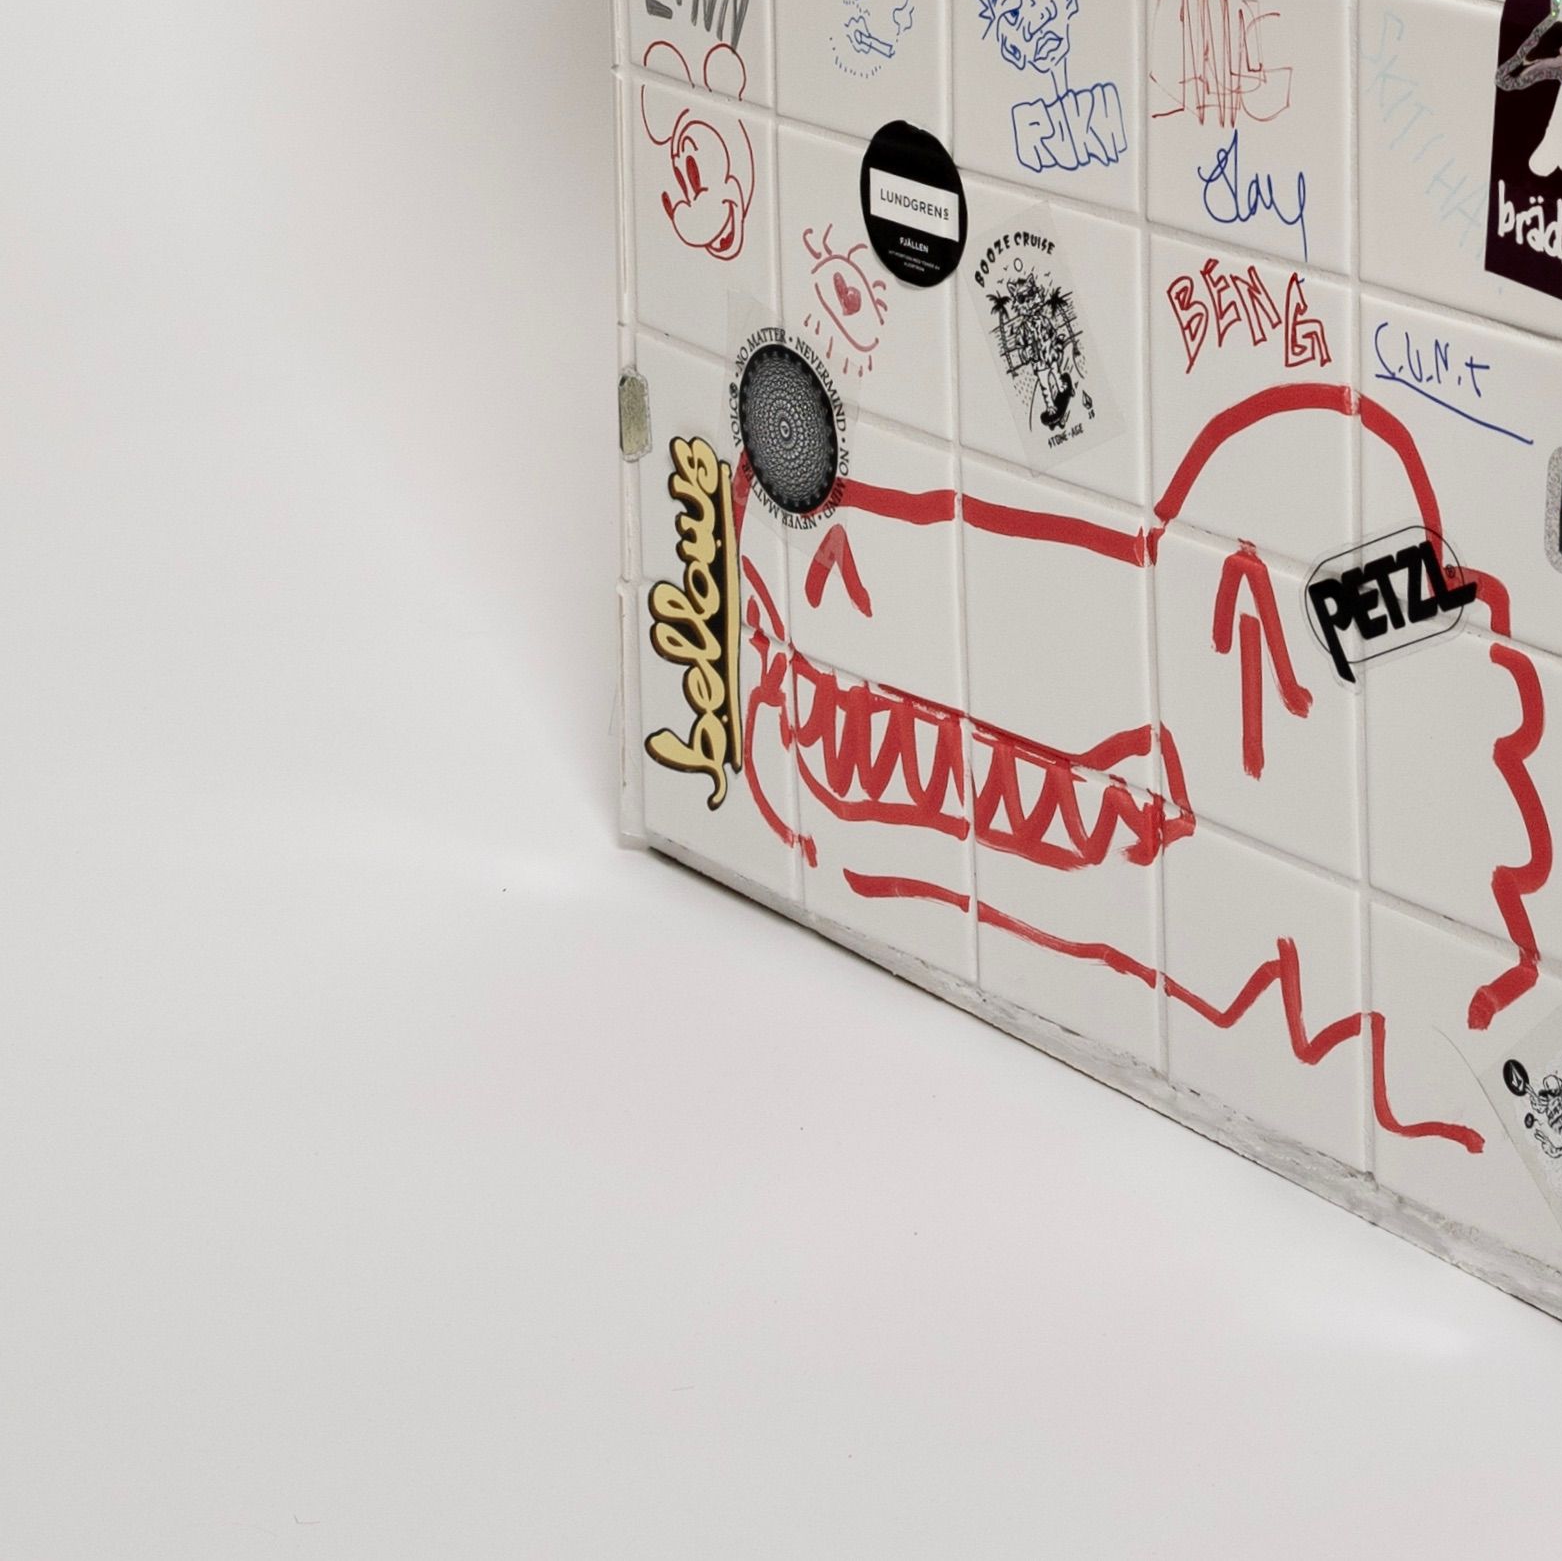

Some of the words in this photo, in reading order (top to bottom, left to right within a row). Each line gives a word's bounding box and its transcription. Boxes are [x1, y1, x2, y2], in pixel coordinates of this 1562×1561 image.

[880, 188, 950, 220] LUNDGRENS
[974, 234, 1011, 288] BOOZE
[1013, 231, 1056, 256] CRUISE
[1167, 257, 1332, 374] BENG
[795, 336, 847, 433] NEVERMIND
[644, 435, 743, 813] bellows
[1308, 538, 1477, 682] PETZL
